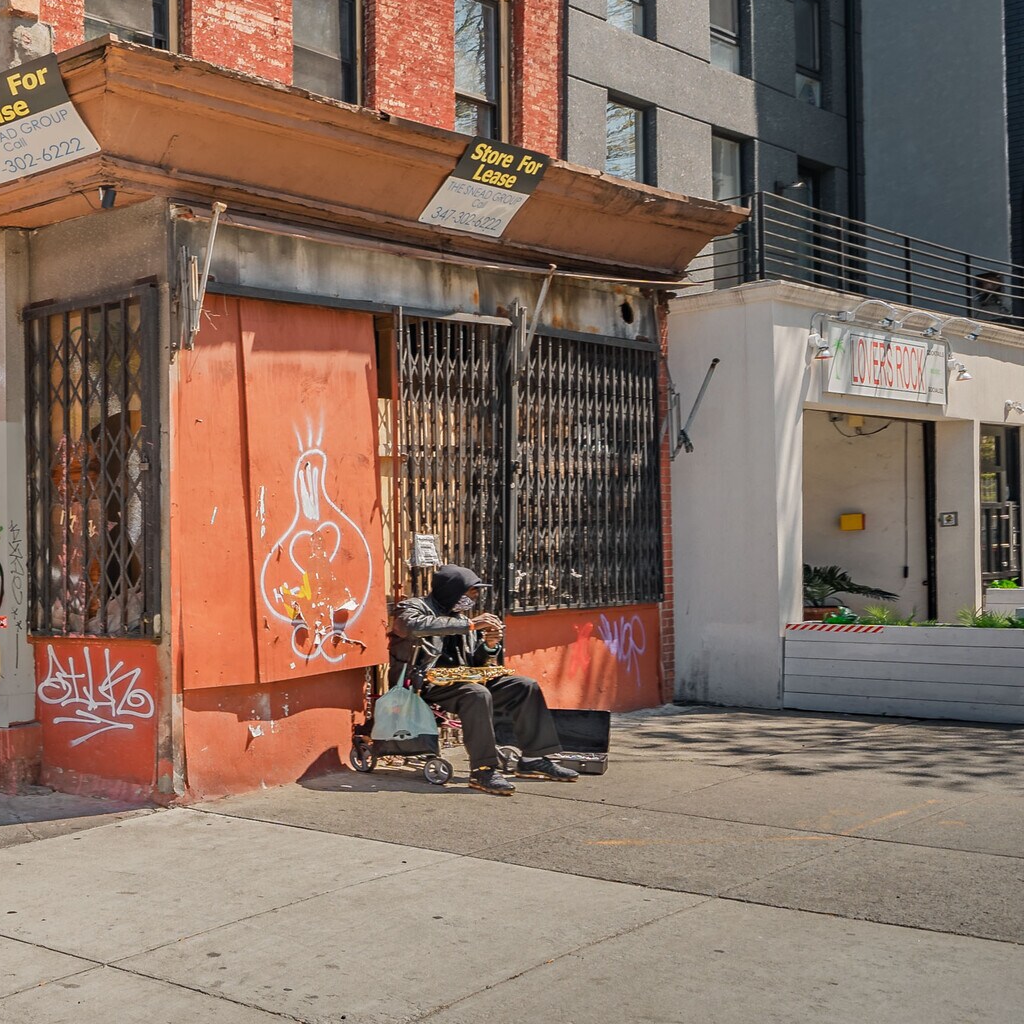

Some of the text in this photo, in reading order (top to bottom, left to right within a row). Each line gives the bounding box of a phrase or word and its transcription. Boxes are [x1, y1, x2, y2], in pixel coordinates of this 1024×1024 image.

[7, 67, 48, 96] For
[20, 109, 68, 134] GROUP
[3, 137, 28, 152] Call
[471, 143, 544, 175] Store For
[472, 164, 517, 188] Lease
[447, 181, 523, 206] THE SNEAD GROUP
[431, 207, 502, 231] 347-302-6222
[851, 338, 925, 391] LOVERS ROCK
